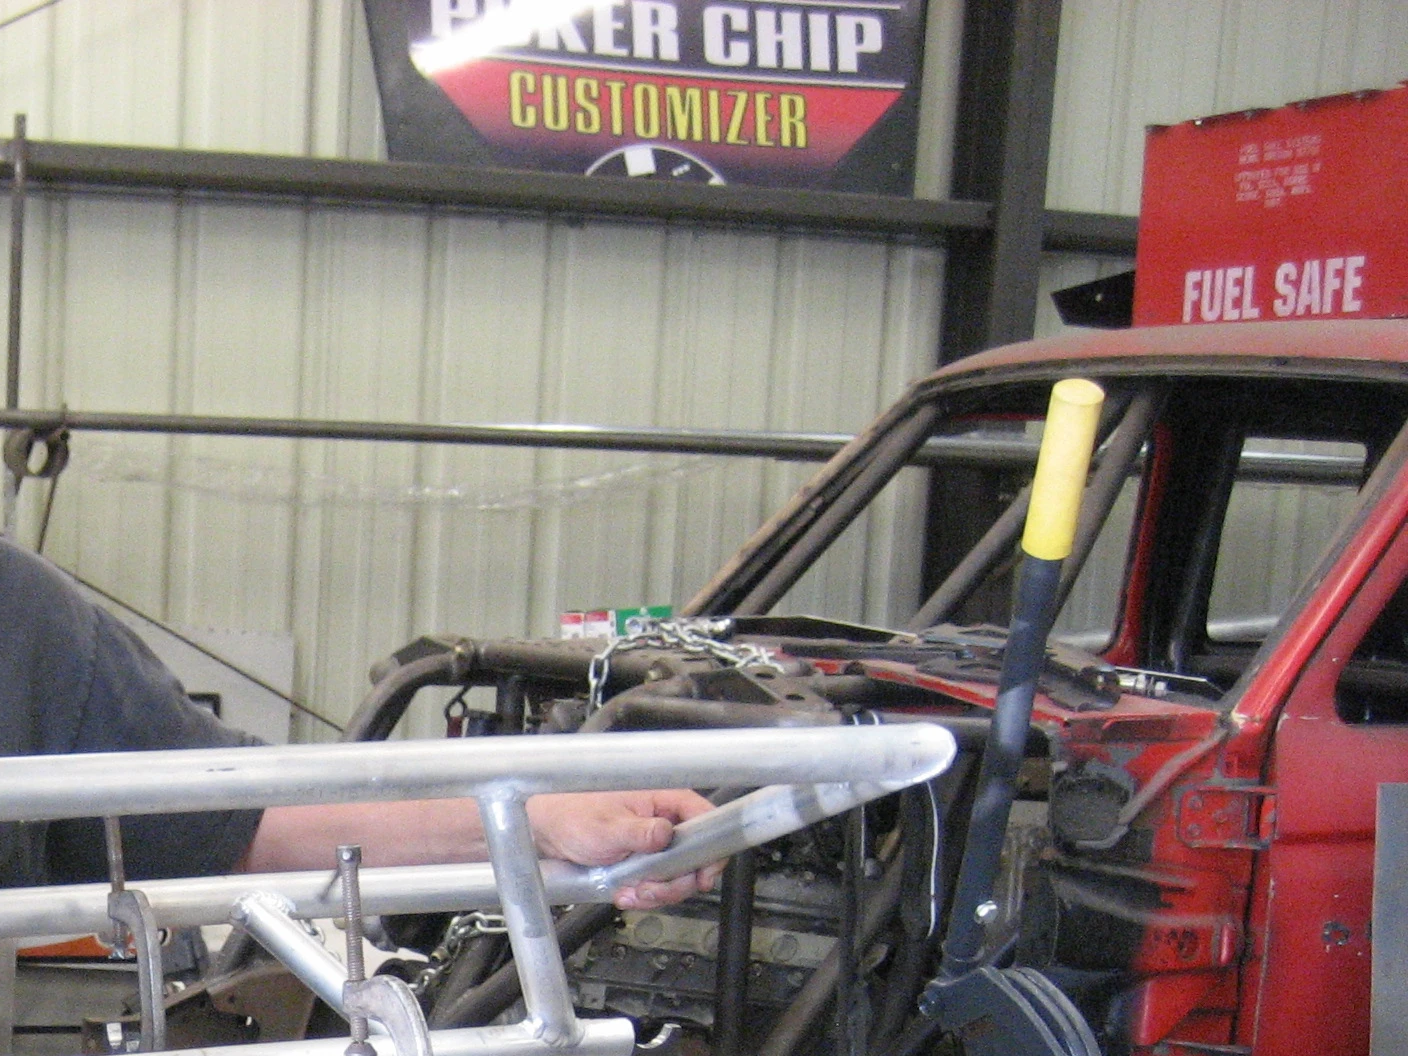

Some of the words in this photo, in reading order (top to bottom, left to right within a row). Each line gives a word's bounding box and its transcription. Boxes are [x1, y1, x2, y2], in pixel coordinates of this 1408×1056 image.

[430, 0, 681, 61] PKER
[703, 5, 883, 73] CHIP
[508, 70, 809, 149] CUSTOMIZER
[1181, 264, 1261, 324] FUEL
[1272, 255, 1367, 318] SAFE
